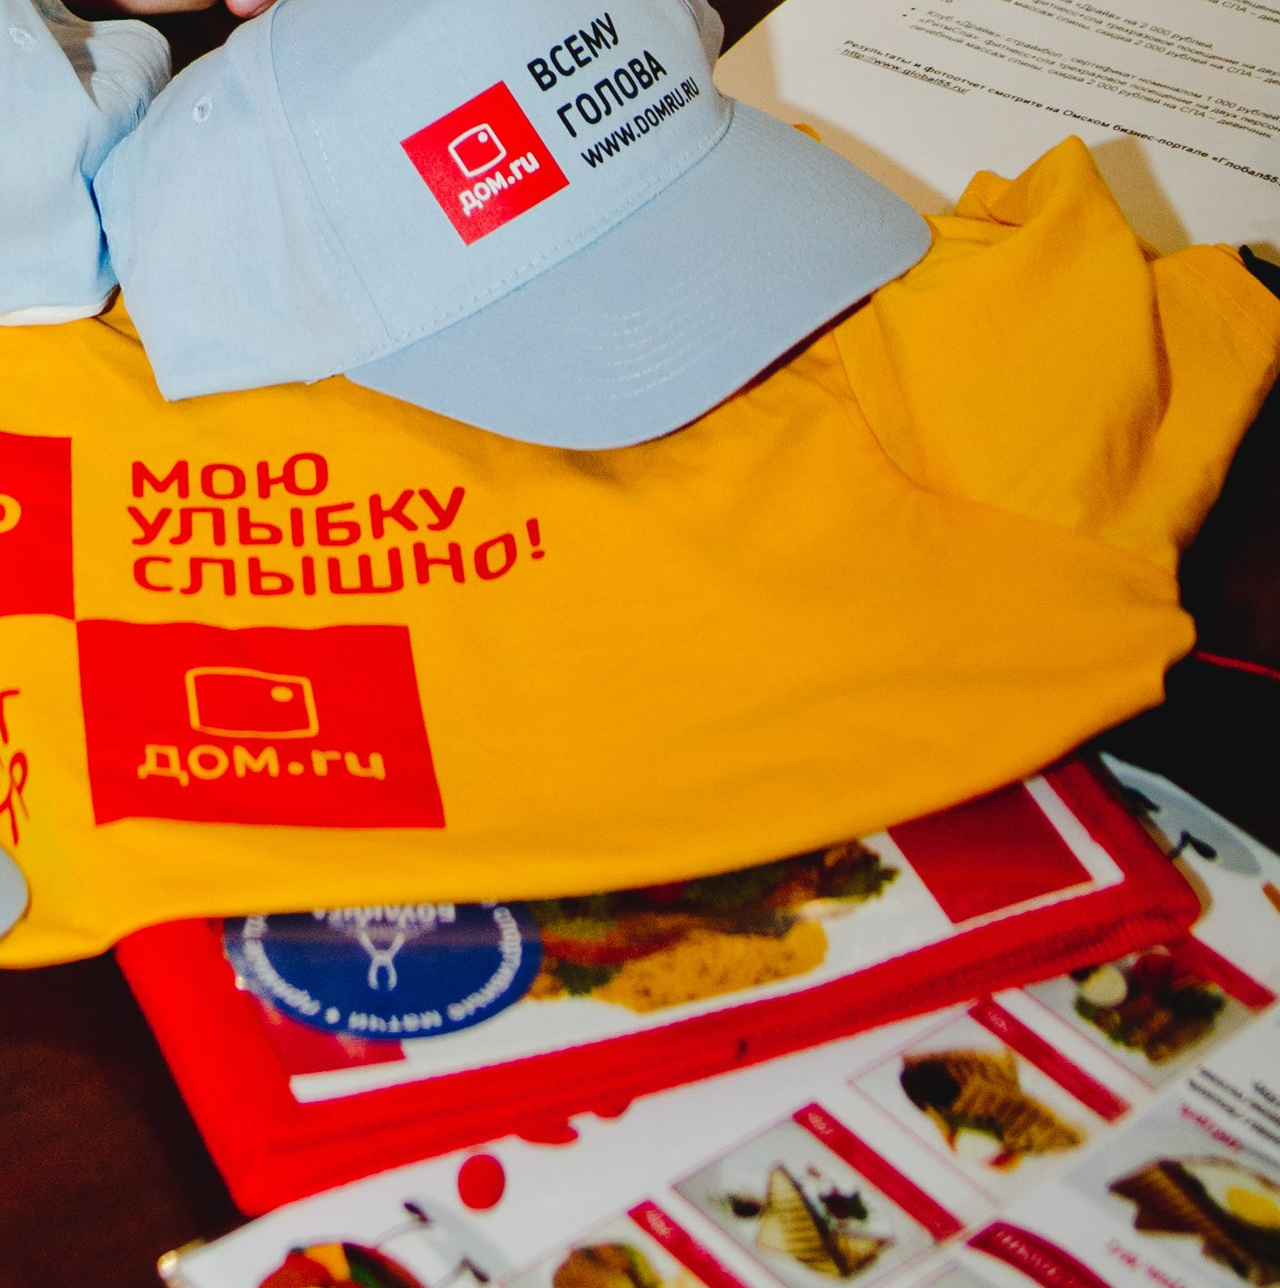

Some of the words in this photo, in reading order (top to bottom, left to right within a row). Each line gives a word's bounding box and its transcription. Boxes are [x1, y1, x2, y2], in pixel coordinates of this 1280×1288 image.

[527, 12, 619, 92] ВСЕМУ
[556, 50, 668, 138] ГОЛОВА
[580, 76, 700, 169] WWW.DOMRU.RU
[1062, 109, 1110, 127] Омском
[1212, 156, 1280, 183] «Глобал55.
[131, 452, 329, 500] МОЮ
[127, 486, 466, 548] УЛЫБКУ
[131, 517, 546, 597] СЛЫШНО!
